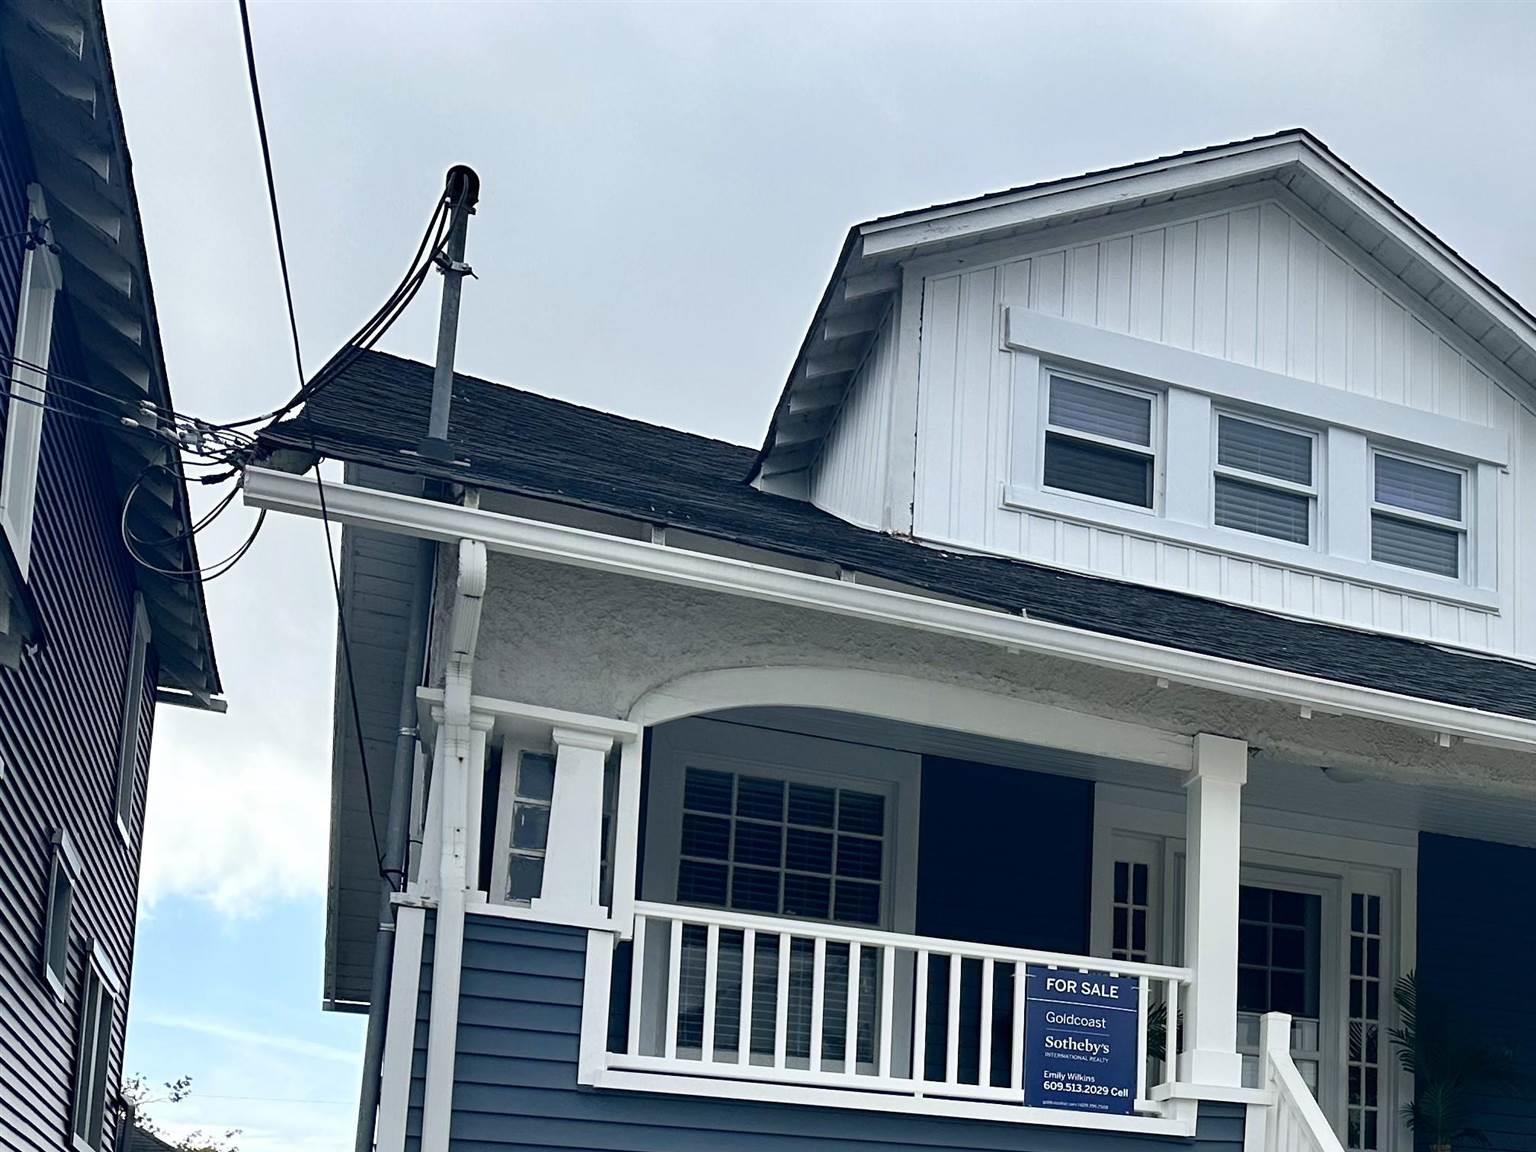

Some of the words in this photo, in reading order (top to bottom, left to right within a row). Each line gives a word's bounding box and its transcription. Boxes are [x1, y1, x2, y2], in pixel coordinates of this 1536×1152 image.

[1046, 978, 1077, 994] FOR
[1081, 982, 1119, 999] SALE
[1046, 1011, 1106, 1029] Goldcoast
[1045, 1036, 1110, 1055] Sotheby's
[1045, 1052, 1089, 1062] INTERNATIONAL
[1043, 1070, 1066, 1081] Emily
[1067, 1073, 1095, 1082] Wilkins
[1043, 1081, 1109, 1096] 609.513.2029
[1110, 1087, 1129, 1098] Cell
